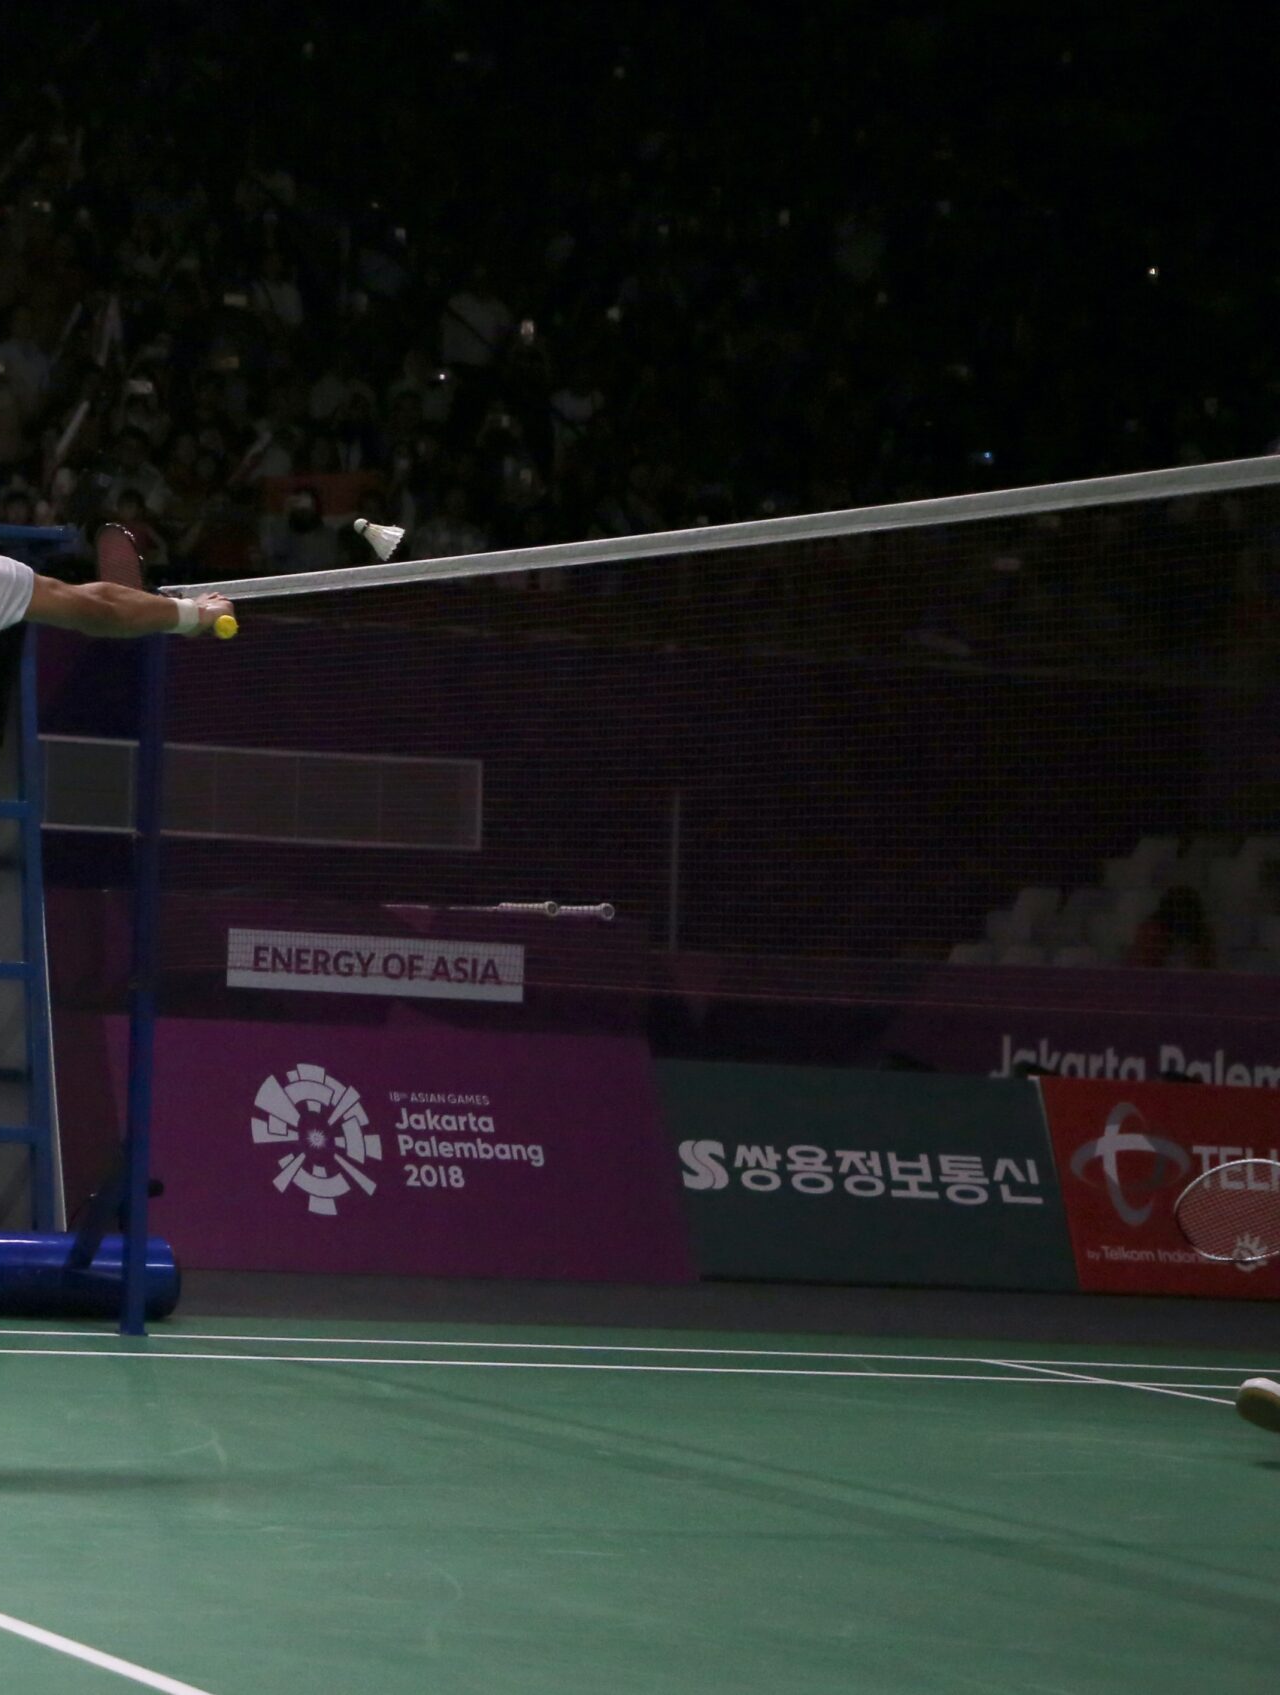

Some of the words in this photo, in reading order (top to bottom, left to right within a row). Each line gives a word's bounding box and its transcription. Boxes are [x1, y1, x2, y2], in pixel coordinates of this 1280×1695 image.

[252, 945, 375, 977] ENERGY
[382, 952, 424, 981] OF
[431, 955, 502, 986] ASIA
[410, 1092, 446, 1104] ASIAN
[447, 1093, 490, 1106] GAMES
[395, 1107, 495, 1133] Jakarta
[397, 1134, 545, 1168] Palembang
[403, 1163, 465, 1189] 2018
[733, 1143, 1044, 1206] 쌍용정보통신
